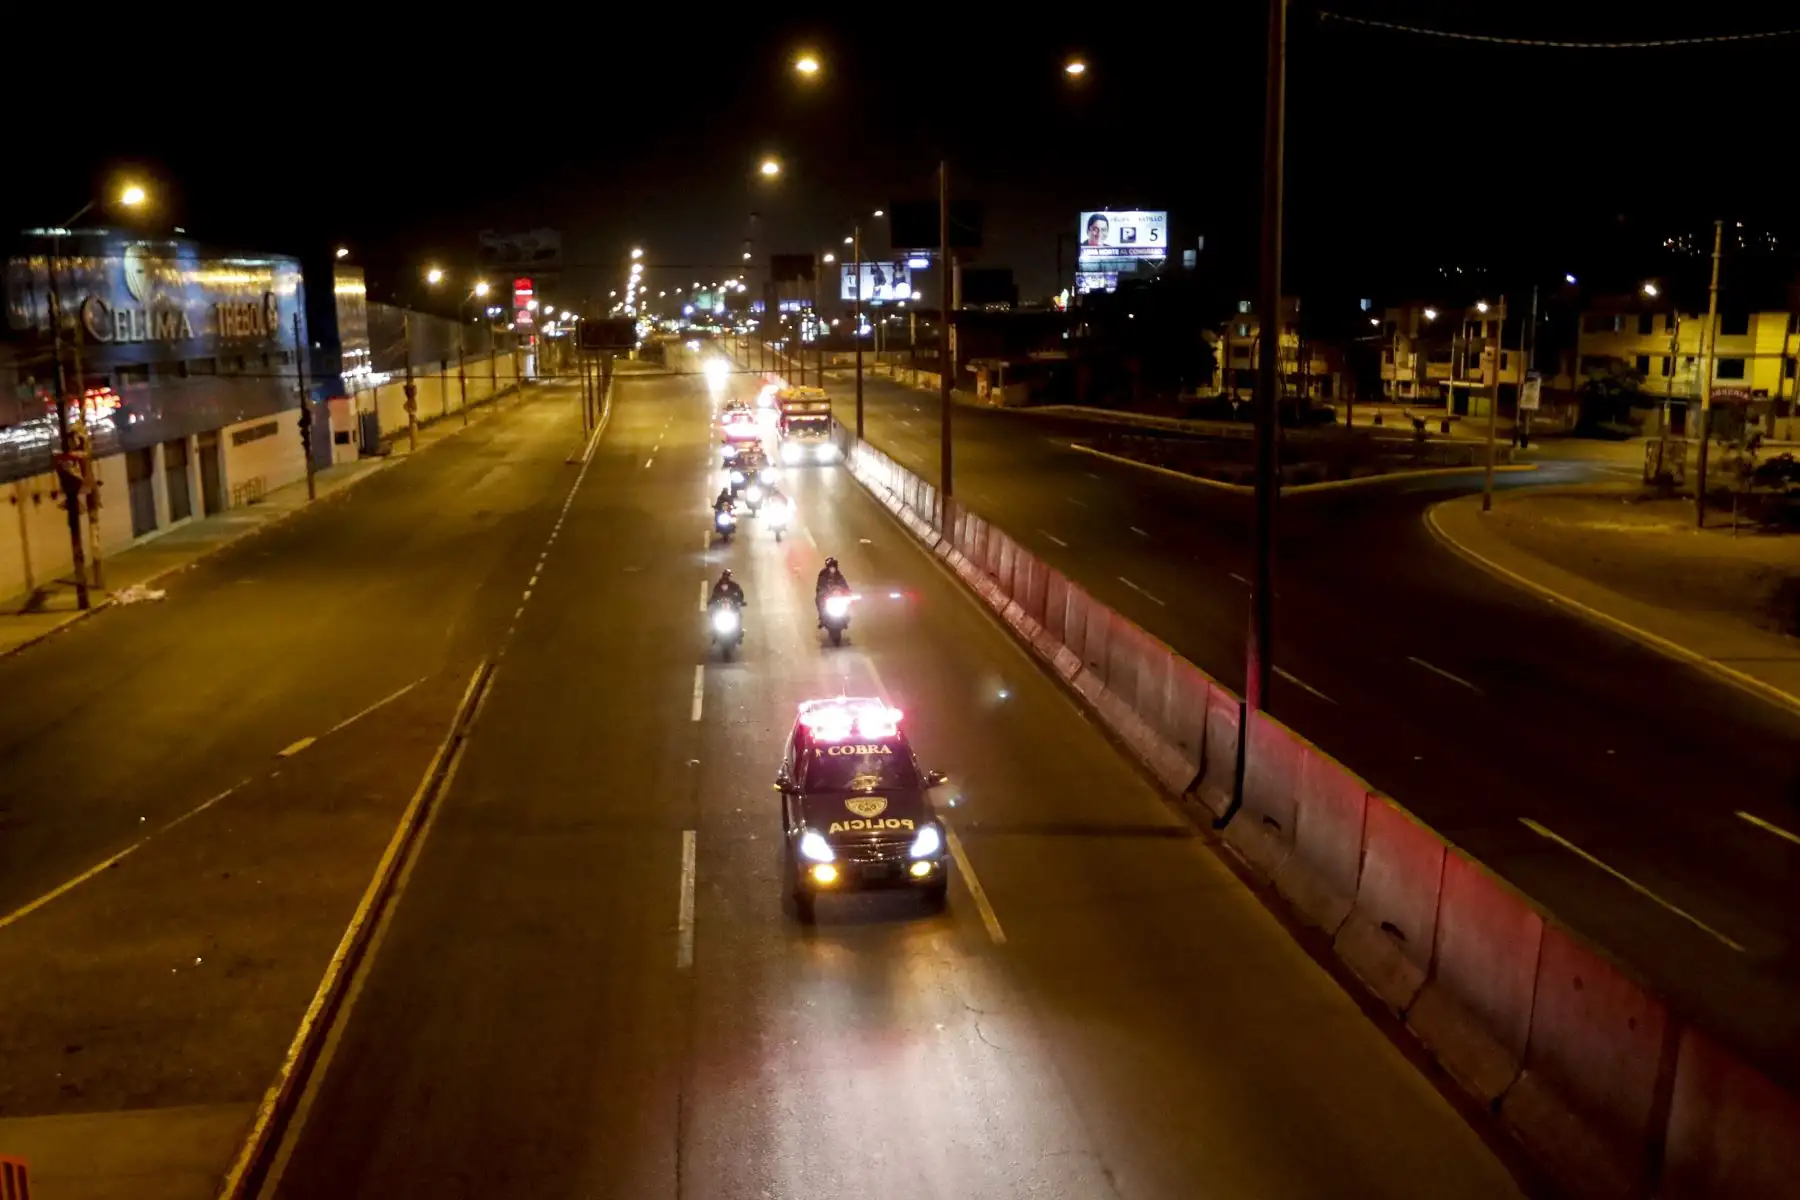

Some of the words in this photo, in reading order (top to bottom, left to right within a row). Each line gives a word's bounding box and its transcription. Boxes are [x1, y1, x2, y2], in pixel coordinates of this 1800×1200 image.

[1149, 228, 1159, 242] 5
[80, 295, 194, 343] CELIMA
[828, 744, 893, 756] COBRA
